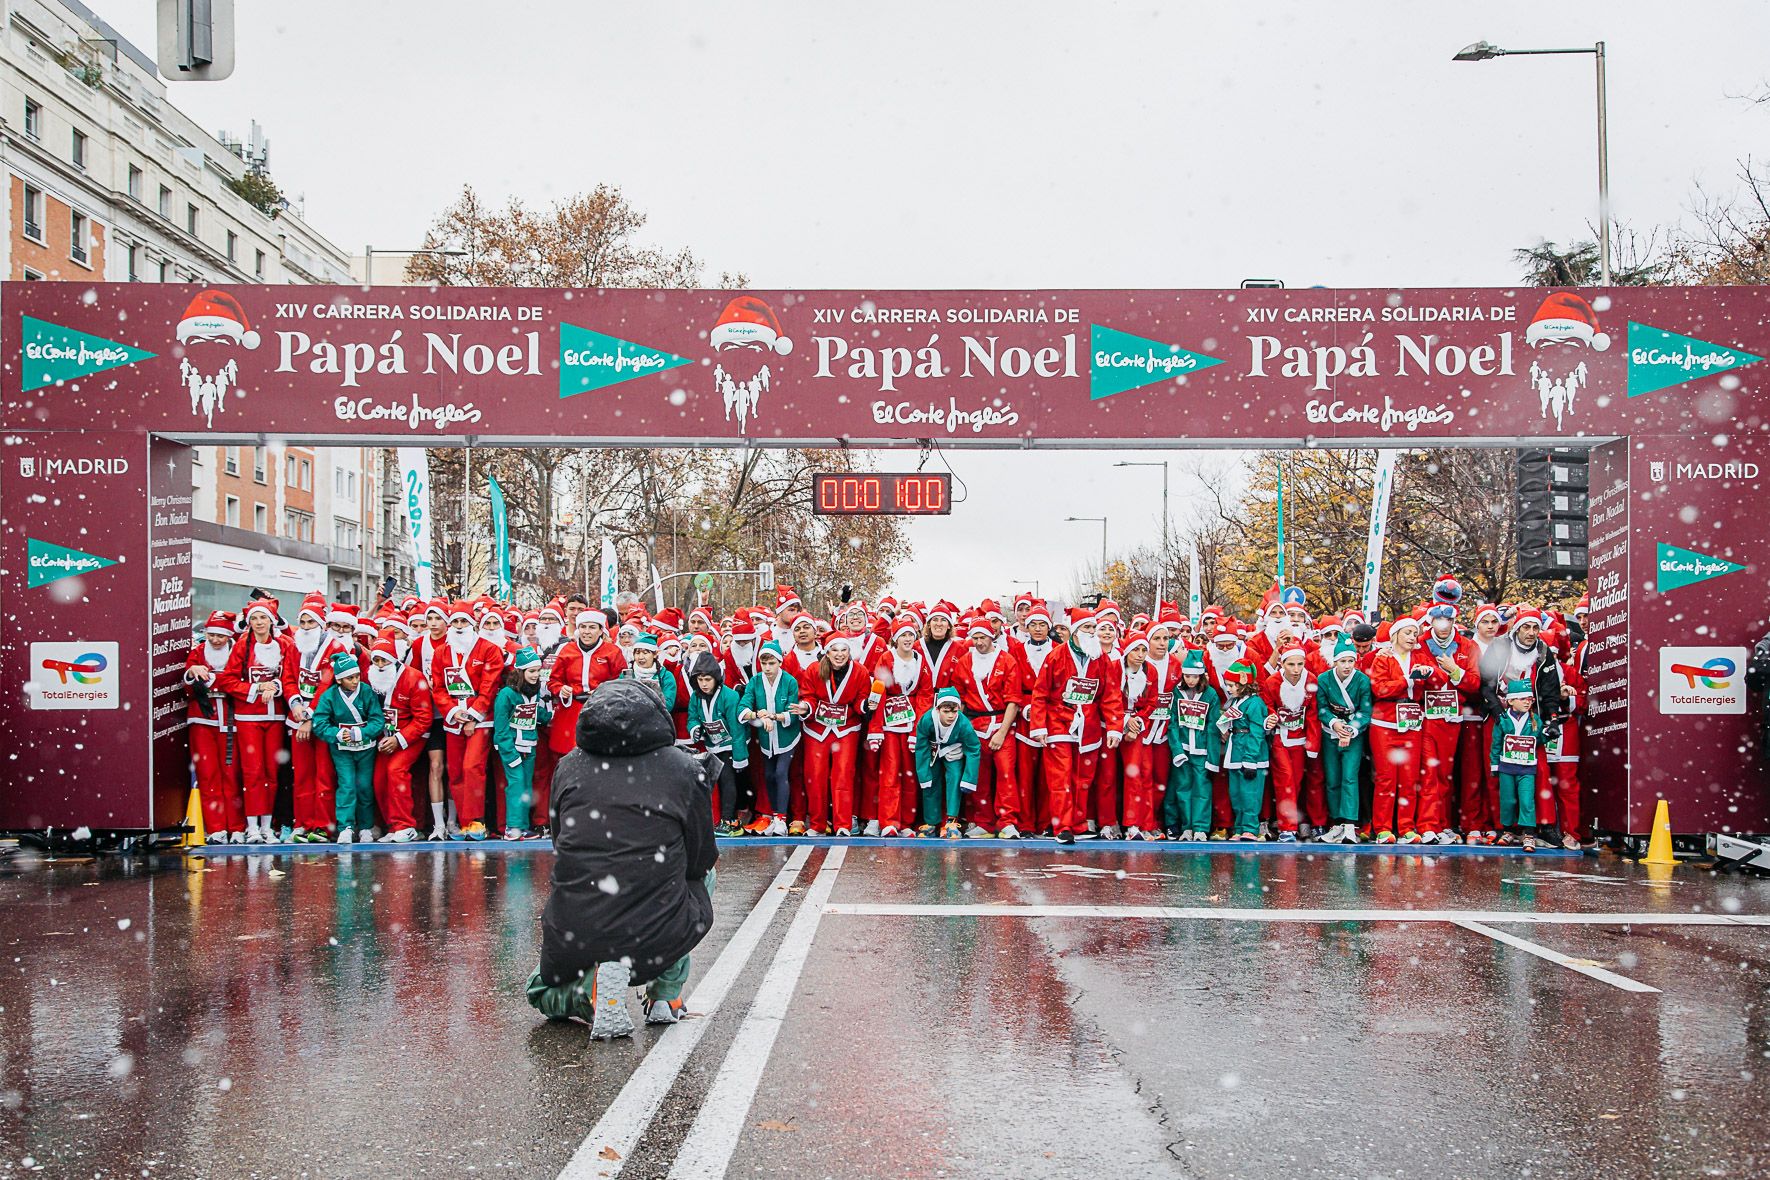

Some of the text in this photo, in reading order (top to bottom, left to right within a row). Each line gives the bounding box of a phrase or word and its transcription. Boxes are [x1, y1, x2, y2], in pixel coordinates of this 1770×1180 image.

[275, 303, 543, 321] XIV CARRERA SOLIDARIA DE
[813, 307, 1080, 324] XIV CARRERA SOLIDARIA DE
[1246, 306, 1515, 323] XIV CARRERA SOLIDARIA DE
[26, 341, 129, 365] El Corte Inglés
[274, 329, 543, 388] Papá Noel
[564, 347, 665, 373] El Corte Inglés
[812, 333, 1080, 391] Papá Noel
[1095, 348, 1197, 374] El Corte Inglés
[1245, 331, 1516, 391] Papá Noel
[1632, 344, 1736, 371] El Corte Inglés
[335, 393, 482, 429] El Corte Inglés
[873, 396, 1019, 432] El Corte Inglés
[1306, 395, 1454, 431] El Corte Inglés
[47, 458, 129, 475] MADRID
[1676, 463, 1759, 479] MADRID
[155, 512, 189, 527] Bon Nadal
[1592, 498, 1625, 527] Bon Nadal
[152, 555, 176, 570] Joyeux
[176, 551, 191, 566] Noël
[1590, 551, 1612, 569] Joyeux
[1613, 540, 1627, 559] Noël
[1660, 559, 1729, 575] El Corte Inglés
[160, 576, 184, 595] Feliz
[1597, 570, 1620, 593] Feliz
[153, 592, 191, 614] Navidad
[1589, 583, 1628, 613] Navidad
[153, 616, 191, 636] Buon Natale
[1589, 610, 1627, 634] Buon Natale
[153, 637, 191, 656] Boas Festas
[1589, 633, 1627, 655] Boas Festas
[42, 690, 108, 701] TotalEnergies
[1671, 695, 1736, 705] TotalEnergies
[1433, 706, 1450, 714] 3132
